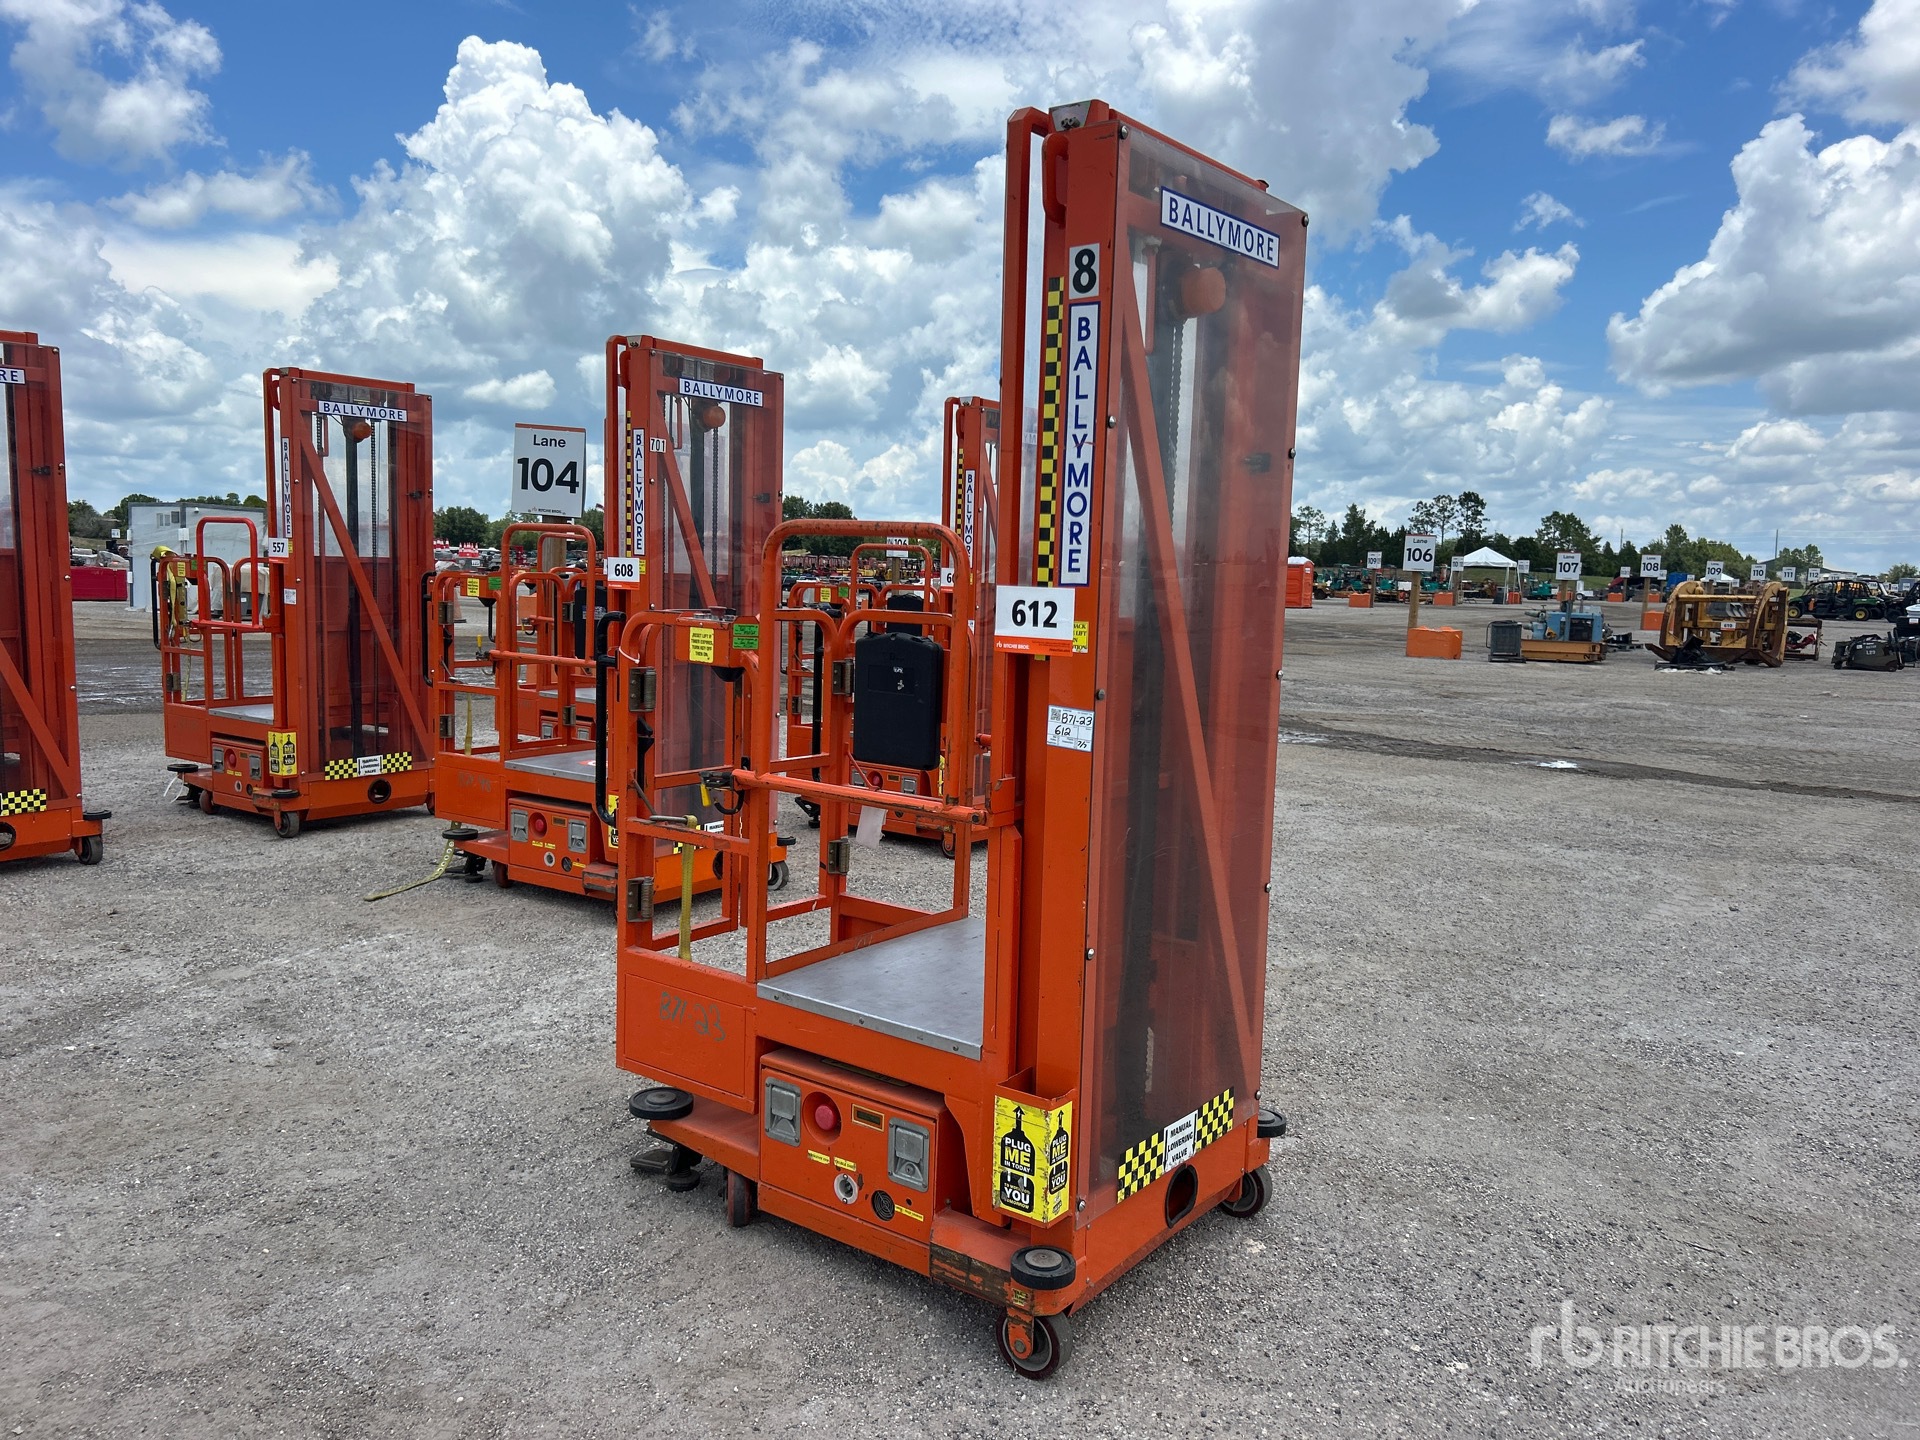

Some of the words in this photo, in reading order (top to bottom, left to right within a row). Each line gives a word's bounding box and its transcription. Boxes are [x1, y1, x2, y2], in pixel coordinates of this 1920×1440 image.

[1169, 196, 1275, 262] BALLYMORE
[1072, 248, 1097, 294] 8
[684, 380, 760, 405] BALLYMORE
[323, 402, 404, 420] BALLYMORE
[533, 434, 567, 448] Lane
[650, 438, 665, 452] 701
[1066, 316, 1093, 573] BALLYMORE
[517, 457, 580, 494] 104
[283, 441, 292, 534] BALLYMORE
[634, 433, 644, 550] BALLYMORE
[964, 473, 974, 557] BALLYMOR
[272, 542, 285, 553] 557
[1406, 547, 1433, 562] 106
[614, 563, 634, 577] 608
[1558, 562, 1579, 573] 107
[1642, 562, 1660, 572] 108
[1706, 567, 1722, 575] 109
[1752, 569, 1764, 577] 110
[1011, 599, 1058, 629] 612
[1054, 725, 1072, 737] 612
[1170, 1120, 1192, 1138] MANUAL
[1004, 1136, 1031, 1153] PLUG
[1052, 1134, 1067, 1148] PLUG
[1167, 1131, 1194, 1153] LOWERING
[1004, 1147, 1031, 1168] ME
[1052, 1142, 1067, 1159] ME
[1172, 1147, 1188, 1163] VALVE
[1012, 1162, 1031, 1174] TODAY
[1051, 1174, 1066, 1188] YOU
[1004, 1187, 1030, 1205] YOU
